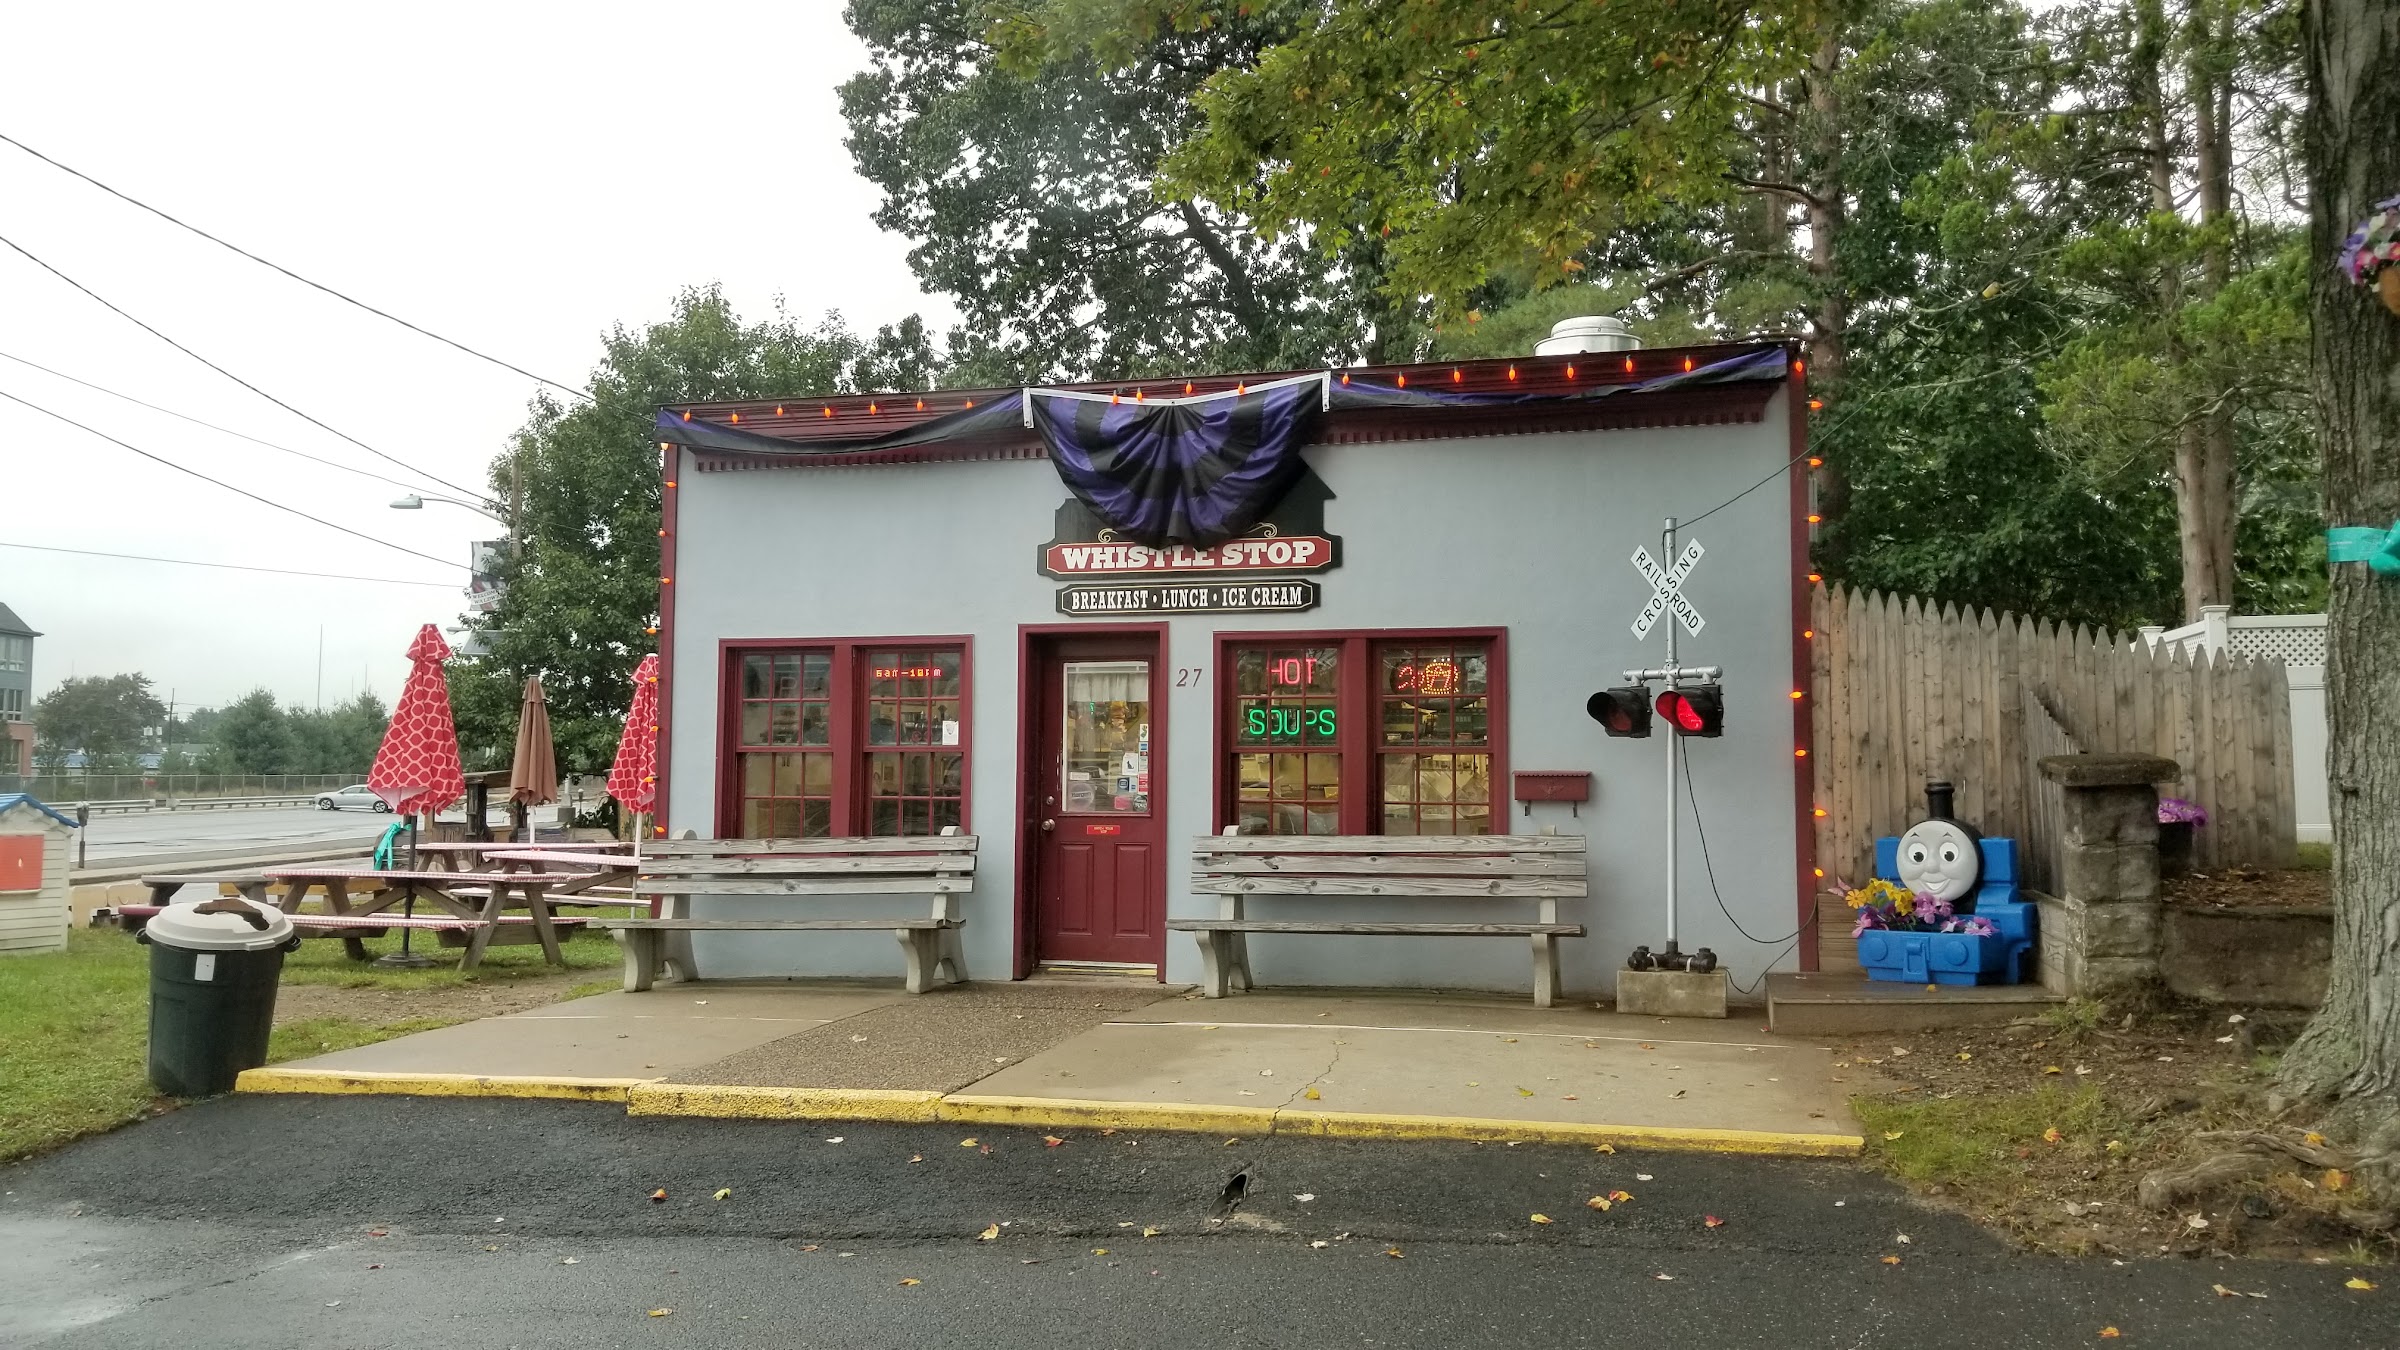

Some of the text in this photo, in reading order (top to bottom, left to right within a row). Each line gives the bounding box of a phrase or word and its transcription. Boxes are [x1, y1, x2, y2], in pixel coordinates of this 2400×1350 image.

[1062, 541, 1316, 569] WHISTLE STOP
[1072, 585, 1303, 609] BREAKFAST LUNCH ICE CREAM
[1637, 546, 1698, 632] CROSSING
[1175, 668, 1203, 687] 27
[1271, 658, 1317, 684] HOT
[1250, 709, 1336, 735] SOUPS
